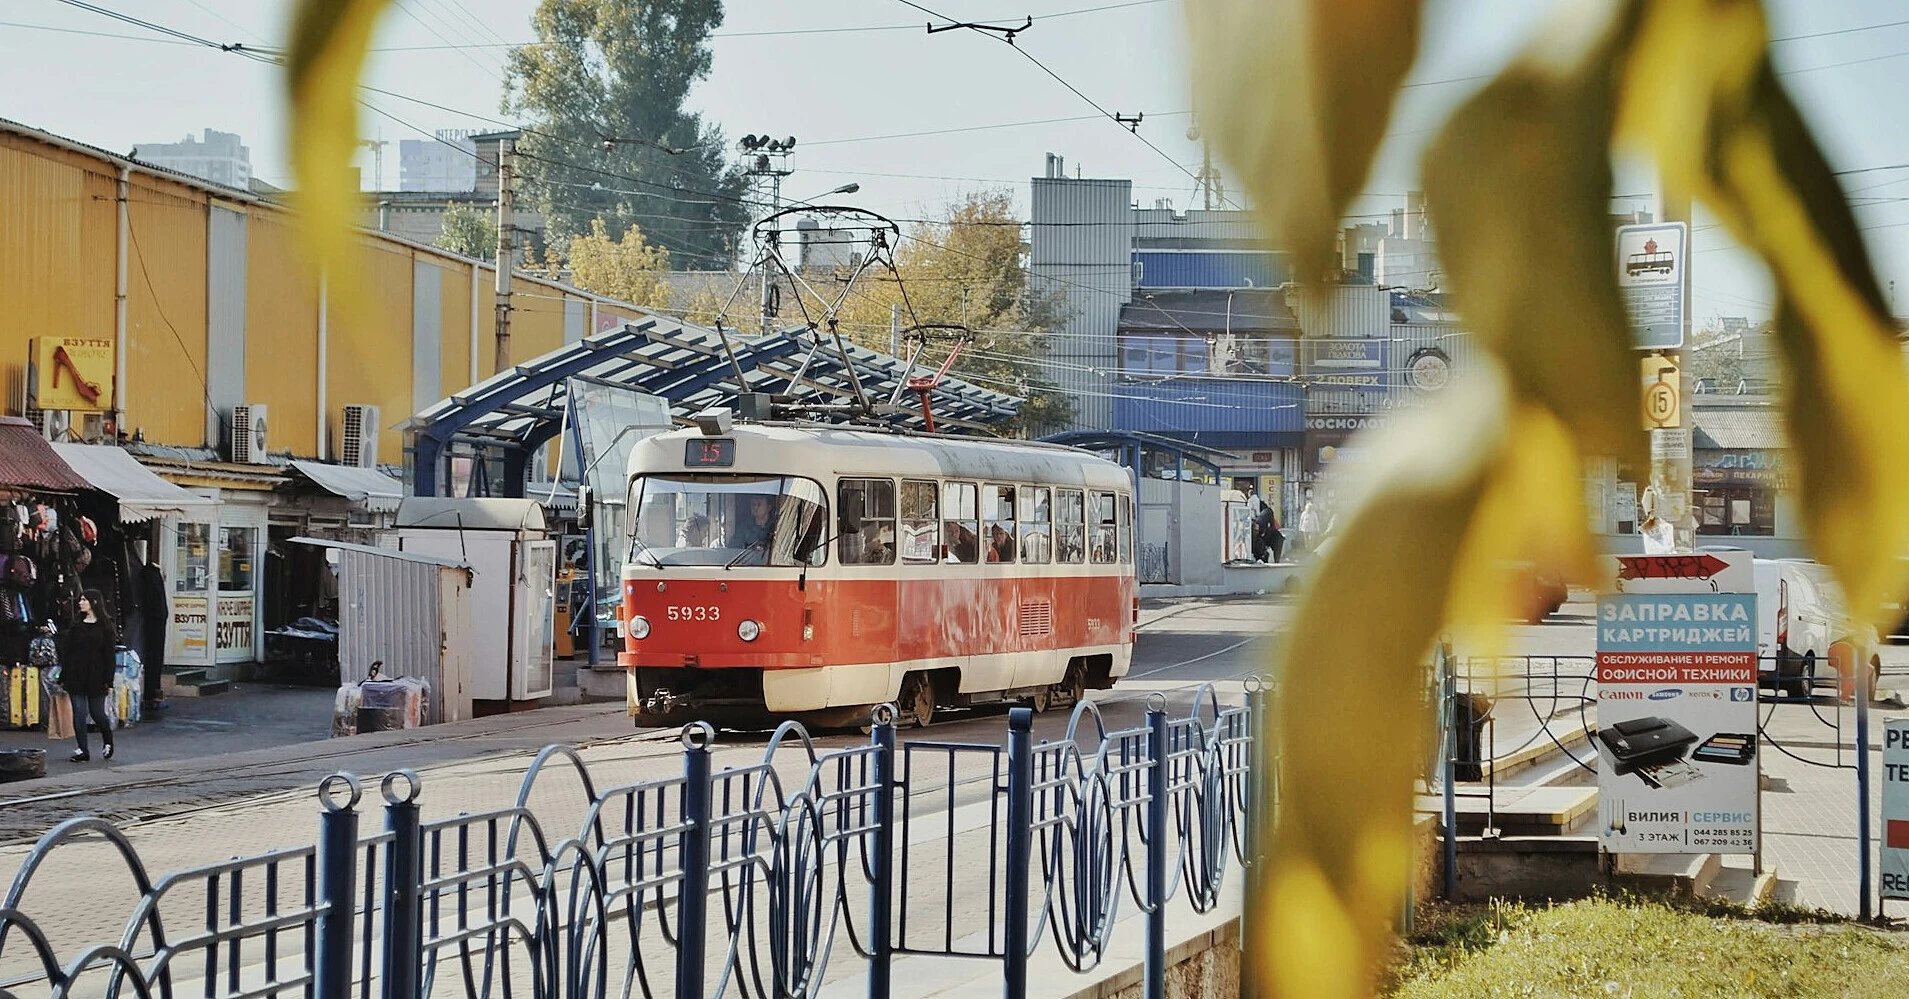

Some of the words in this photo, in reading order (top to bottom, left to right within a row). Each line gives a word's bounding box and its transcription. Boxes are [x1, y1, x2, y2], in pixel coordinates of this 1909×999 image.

[63, 338, 111, 348] ВЗУТТЯ
[1328, 342, 1367, 351] ЗОЛОТА
[1316, 375, 1325, 385] 2
[1329, 376, 1379, 386] ПОВЕРХ
[1653, 391, 1668, 413] 15
[701, 442, 721, 462] 15
[667, 605, 721, 621] 5933
[1603, 603, 1749, 622] ЗАПРАВКА
[174, 613, 207, 624] ВЗУТТЯ
[216, 621, 251, 649] ВЗУТТЯ
[1603, 625, 1750, 644] КАРТРИДЖЕЙ
[1602, 655, 1693, 664] ОБСЛУЖИВАНИЕ
[1695, 656, 1703, 664] И
[1705, 656, 1749, 664] РЕМОНТ
[1602, 667, 1678, 680] ОФИСНОЙ
[1682, 669, 1750, 680] ТЕХНИКИ
[1599, 689, 1643, 700] Canon
[1688, 690, 1712, 699] xerox
[1628, 812, 1680, 822] ВИЛИЯ
[1693, 812, 1753, 823] СЕРВИС
[1639, 833, 1645, 842] 3
[1648, 833, 1680, 842] ЭТАЖ
[1694, 838, 1711, 846] 067
[1712, 838, 1728, 846] 209
[1742, 838, 1753, 846] 36
